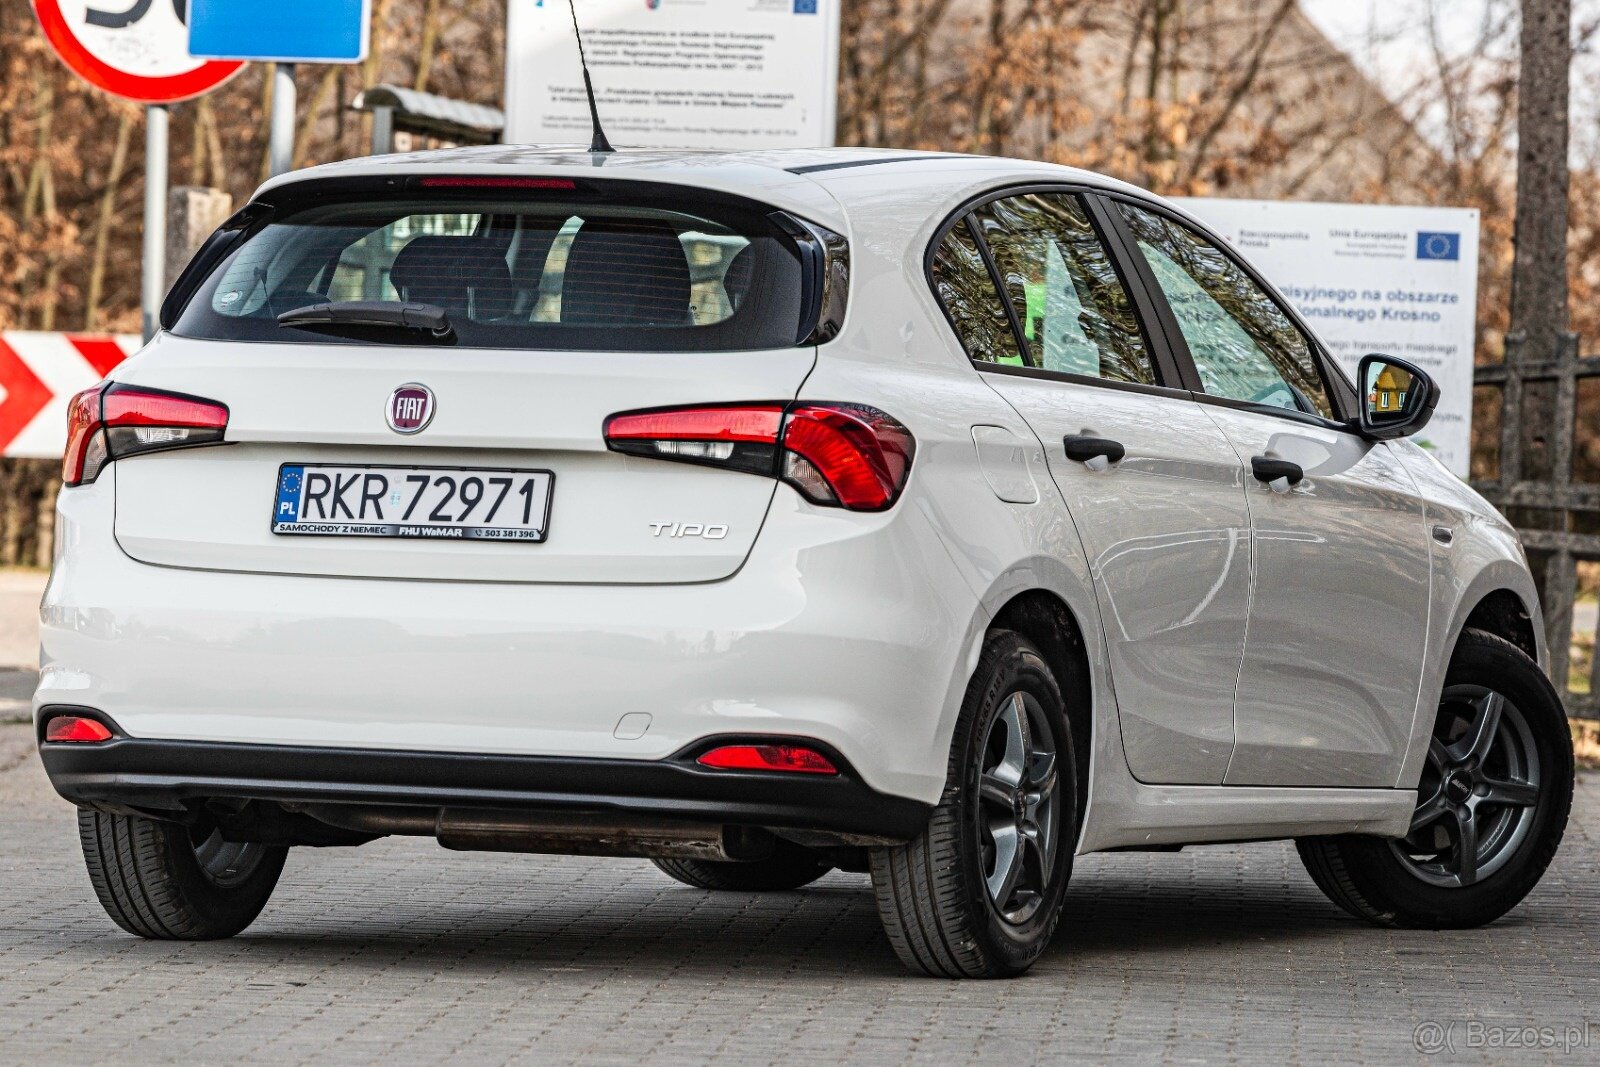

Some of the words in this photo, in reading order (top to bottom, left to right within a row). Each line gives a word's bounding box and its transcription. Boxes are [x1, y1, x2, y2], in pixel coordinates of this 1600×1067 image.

[1361, 289, 1381, 300] na
[1388, 286, 1459, 303] obszarze
[1382, 308, 1441, 322] Krosno
[395, 397, 425, 420] FIAT
[301, 473, 388, 520] RKR
[401, 475, 536, 525] 72971
[280, 501, 296, 516] PL
[279, 524, 341, 534] SAMOCHODY
[342, 525, 350, 533] Z
[350, 526, 387, 535] NIEMIEC
[398, 526, 421, 536] FHU
[484, 529, 501, 538] 503
[502, 530, 518, 538] 381
[519, 530, 535, 539] 396
[649, 521, 730, 540] TIPO
